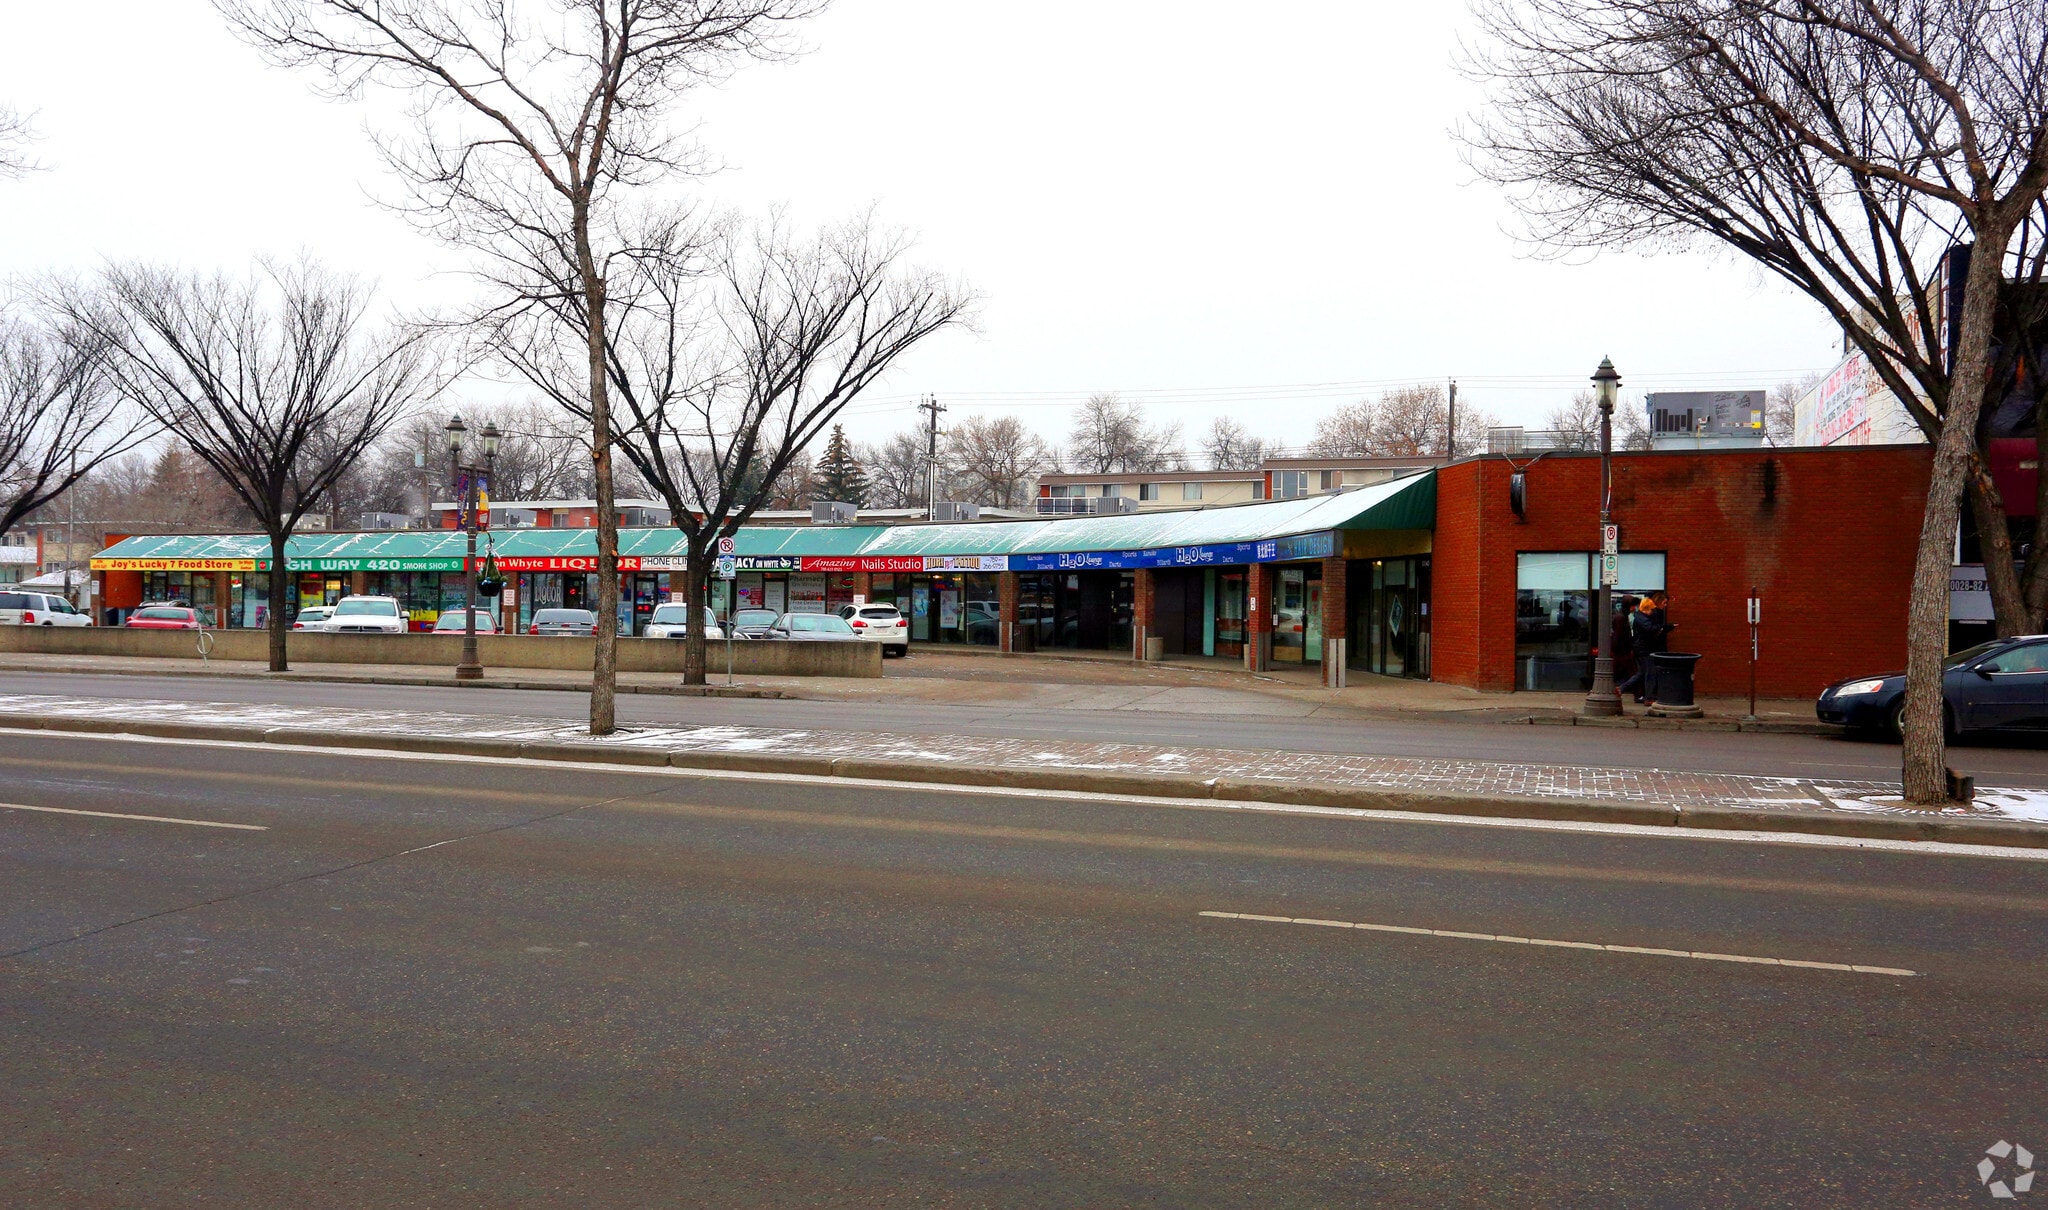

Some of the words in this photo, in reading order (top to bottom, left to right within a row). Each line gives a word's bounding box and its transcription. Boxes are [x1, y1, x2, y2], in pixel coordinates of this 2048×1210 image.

[1309, 535, 1332, 555] DESIGN
[1059, 552, 1085, 569] H2O
[1085, 553, 1103, 566] Lounge
[1122, 551, 1137, 559] Sports
[1176, 546, 1198, 564] H2O
[111, 559, 137, 570] Joy's
[139, 559, 167, 570] Lucky
[169, 560, 176, 568] 7
[178, 560, 202, 569] Food
[204, 560, 233, 569] Store
[269, 560, 312, 571] GH
[320, 559, 360, 570] WAY
[366, 559, 401, 570] 420
[402, 562, 427, 570] SMOKE
[429, 562, 448, 570] SHOP
[508, 558, 544, 570] Whyte
[641, 557, 670, 566] PHONE
[764, 559, 779, 569] WHYTE
[803, 558, 856, 570] Amazing
[861, 558, 885, 570] Nails
[887, 558, 921, 570] Studio
[535, 586, 562, 605] LIQUOR
